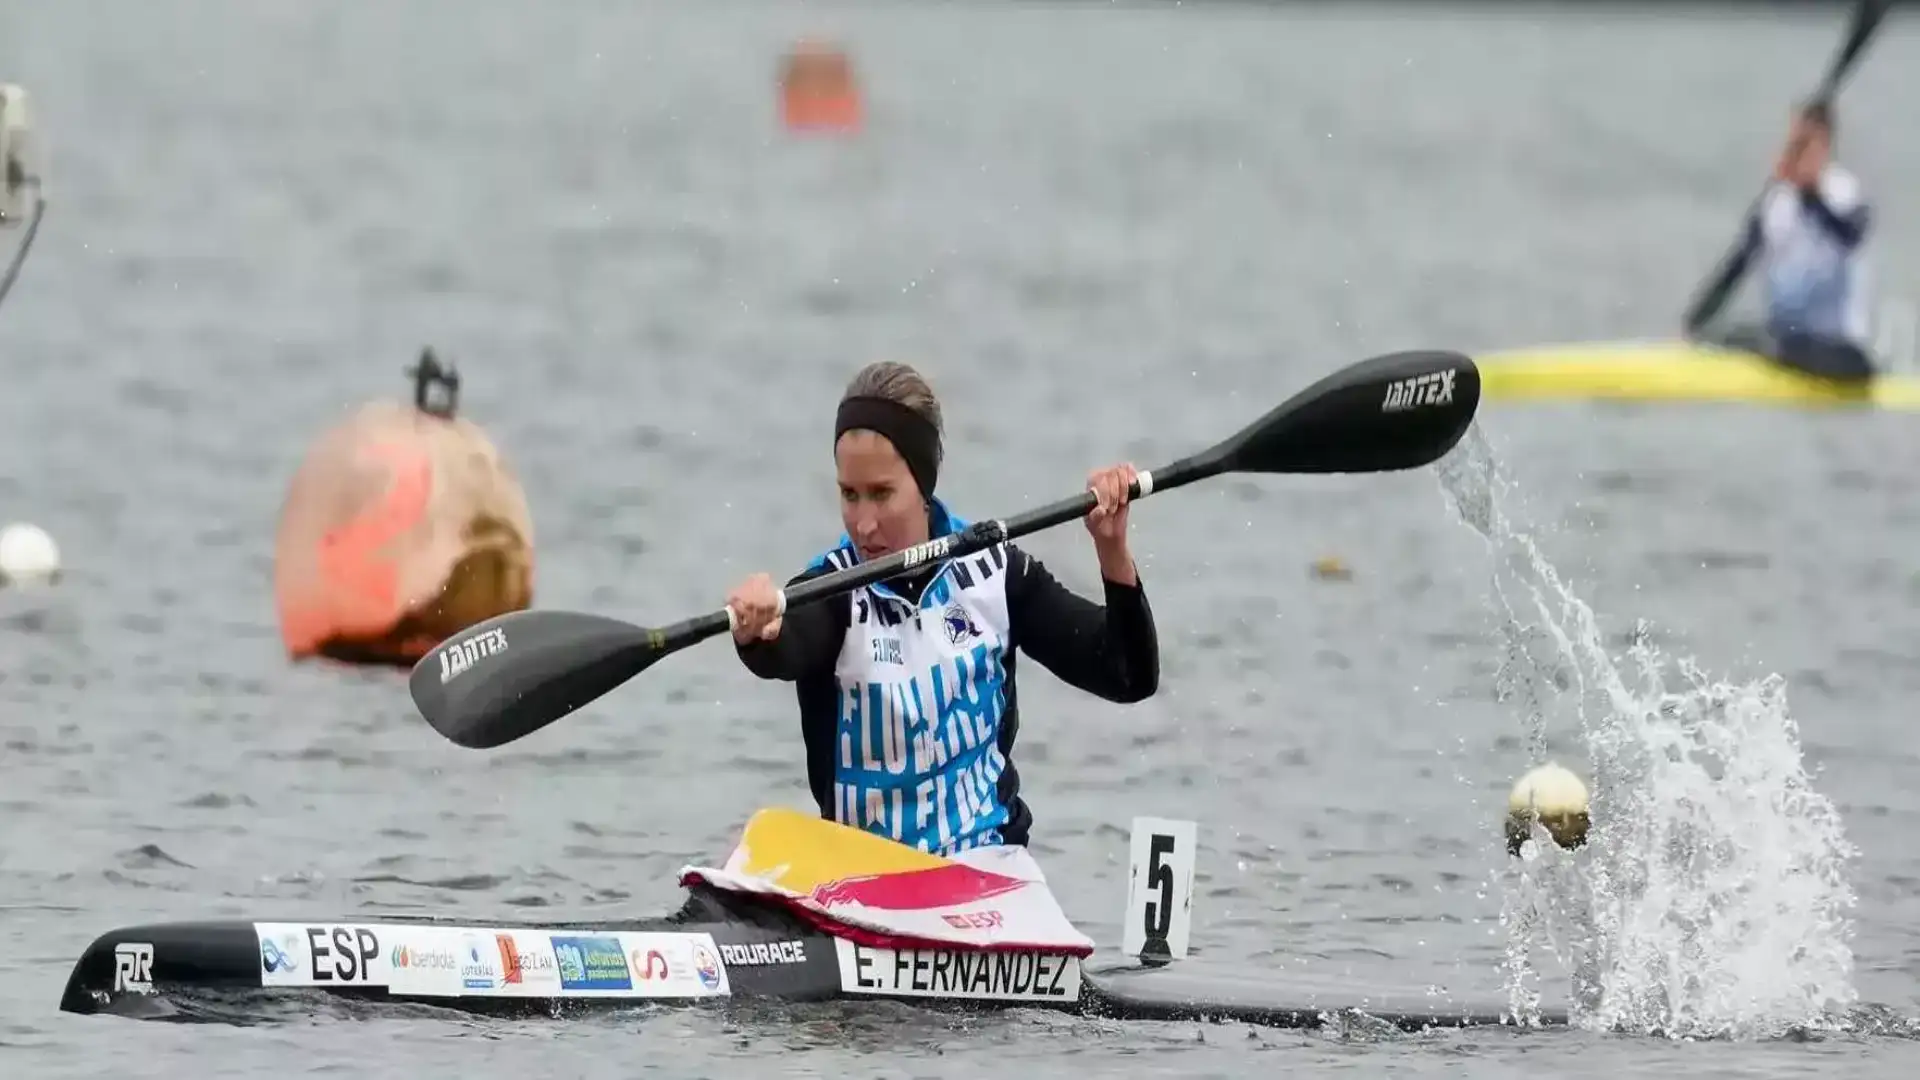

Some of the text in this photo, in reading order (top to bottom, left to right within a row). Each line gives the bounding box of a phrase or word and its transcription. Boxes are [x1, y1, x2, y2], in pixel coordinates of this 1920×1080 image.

[1381, 368, 1456, 412] JANTEX
[440, 626, 508, 685] JANTEX
[1144, 833, 1176, 941] 5
[969, 911, 1004, 929] ESP
[306, 927, 380, 982] ESP
[719, 940, 808, 966] ROURACE
[855, 942, 1069, 996] E. FERNANDEZ
